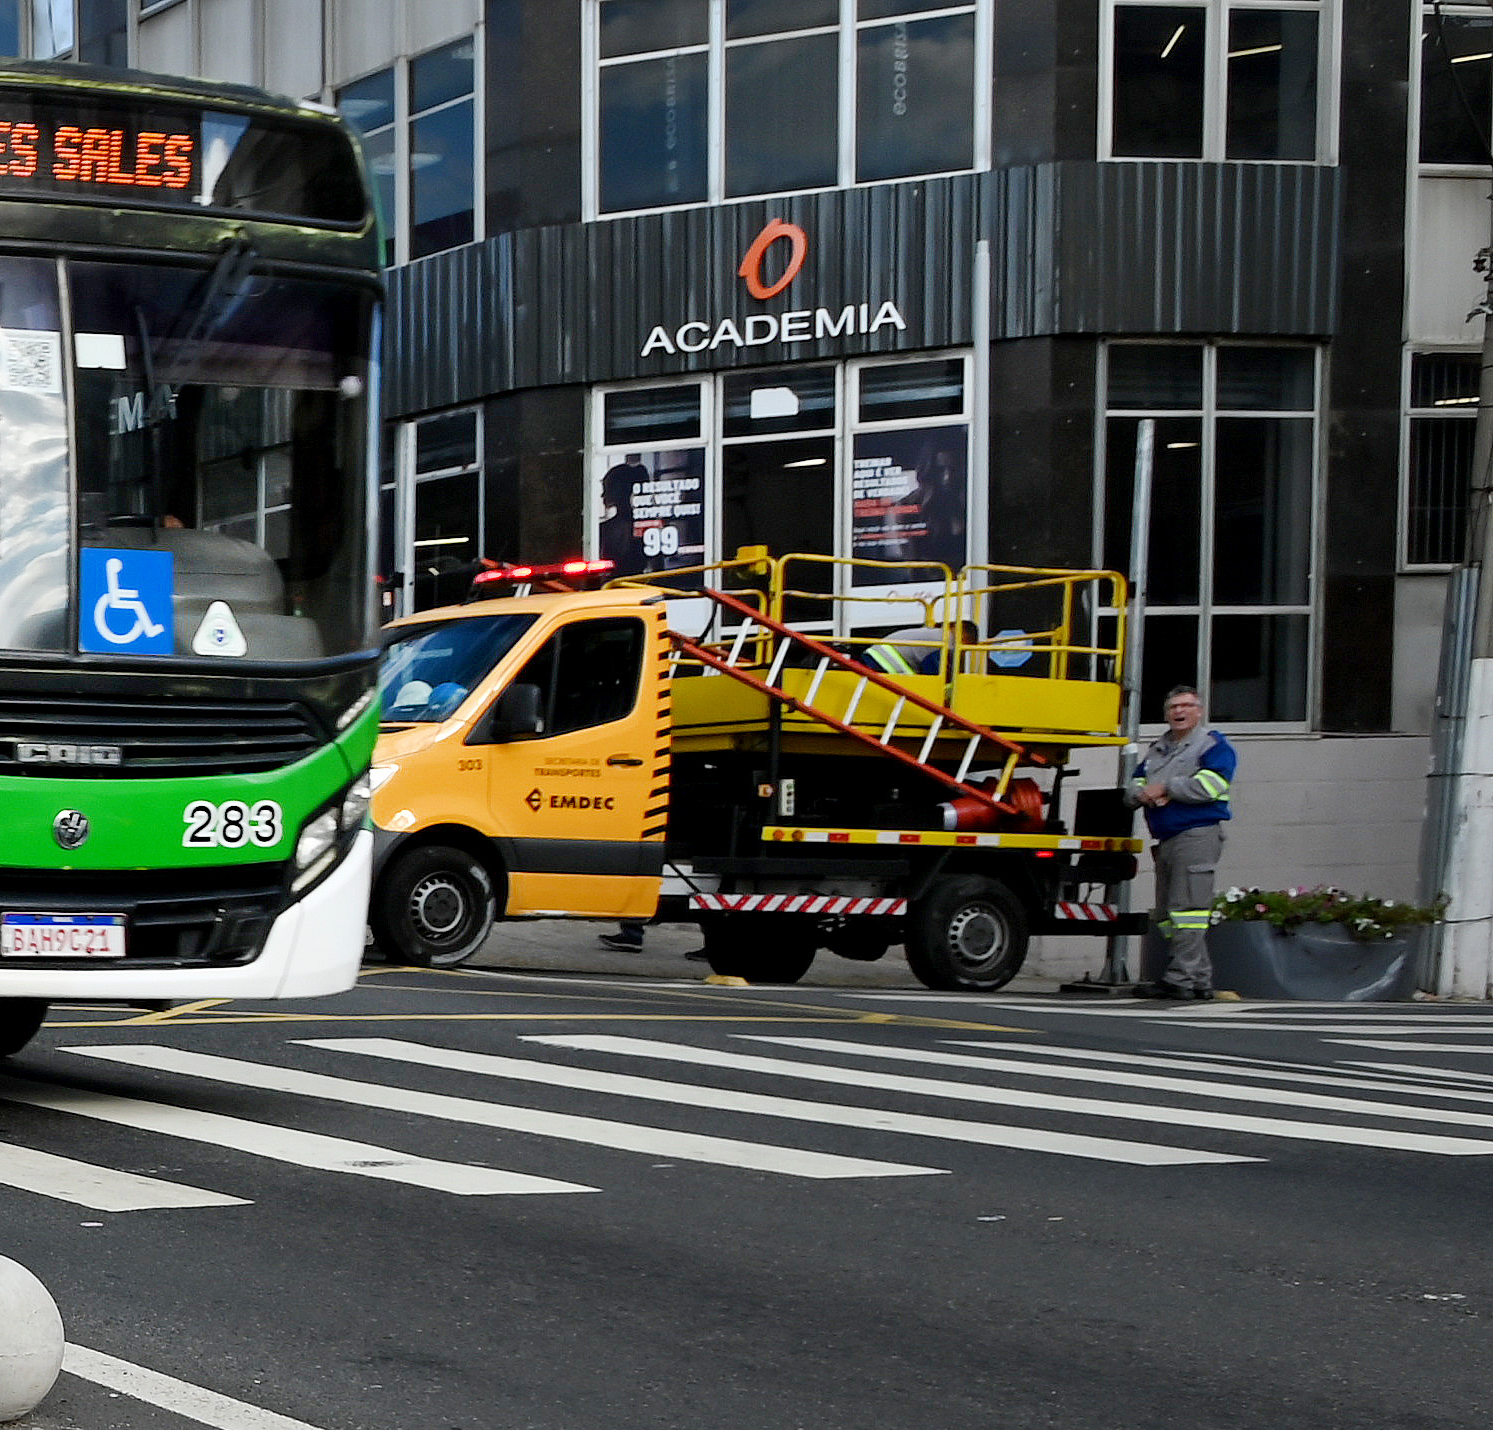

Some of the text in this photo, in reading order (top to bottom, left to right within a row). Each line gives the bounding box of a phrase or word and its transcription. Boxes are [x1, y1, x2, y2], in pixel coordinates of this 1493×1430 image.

[52, 126, 194, 189] SALES
[641, 301, 907, 358] ACADEMIA
[643, 526, 678, 557] 99
[458, 759, 484, 772] 303
[534, 768, 602, 778] TRANSPORTES
[550, 795, 616, 811] EMDEC
[185, 802, 280, 846] 283
[13, 928, 111, 952] BAH9C21
